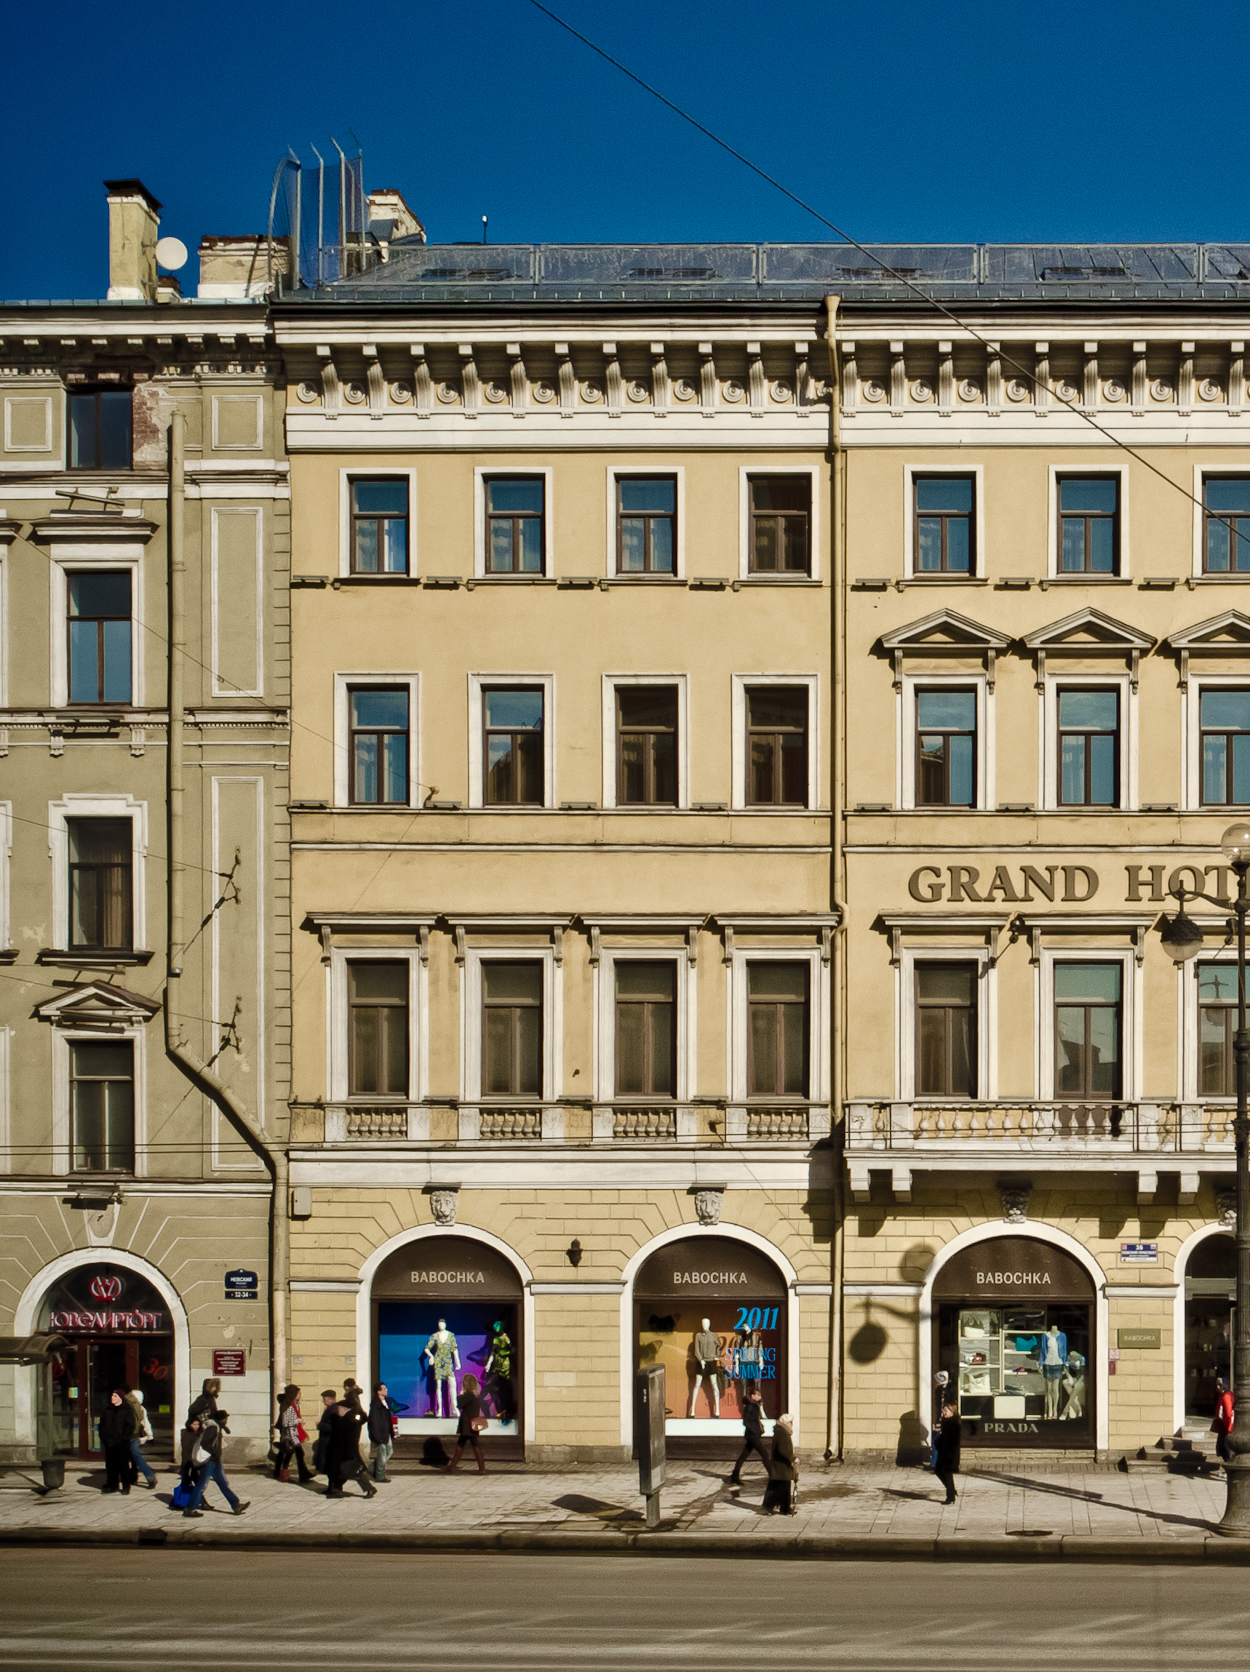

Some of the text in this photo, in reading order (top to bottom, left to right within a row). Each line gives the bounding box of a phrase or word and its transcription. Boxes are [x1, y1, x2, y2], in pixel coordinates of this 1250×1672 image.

[908, 865, 1099, 903] GRAND
[411, 1271, 485, 1283] BABOCHKA
[673, 1271, 748, 1284] BABOCHKA
[976, 1271, 1052, 1284] BABOCHKA
[734, 1306, 779, 1331] 2011
[724, 1347, 777, 1362] SPRING
[724, 1364, 777, 1380] SUMMER
[984, 1422, 1039, 1434] PRADA
